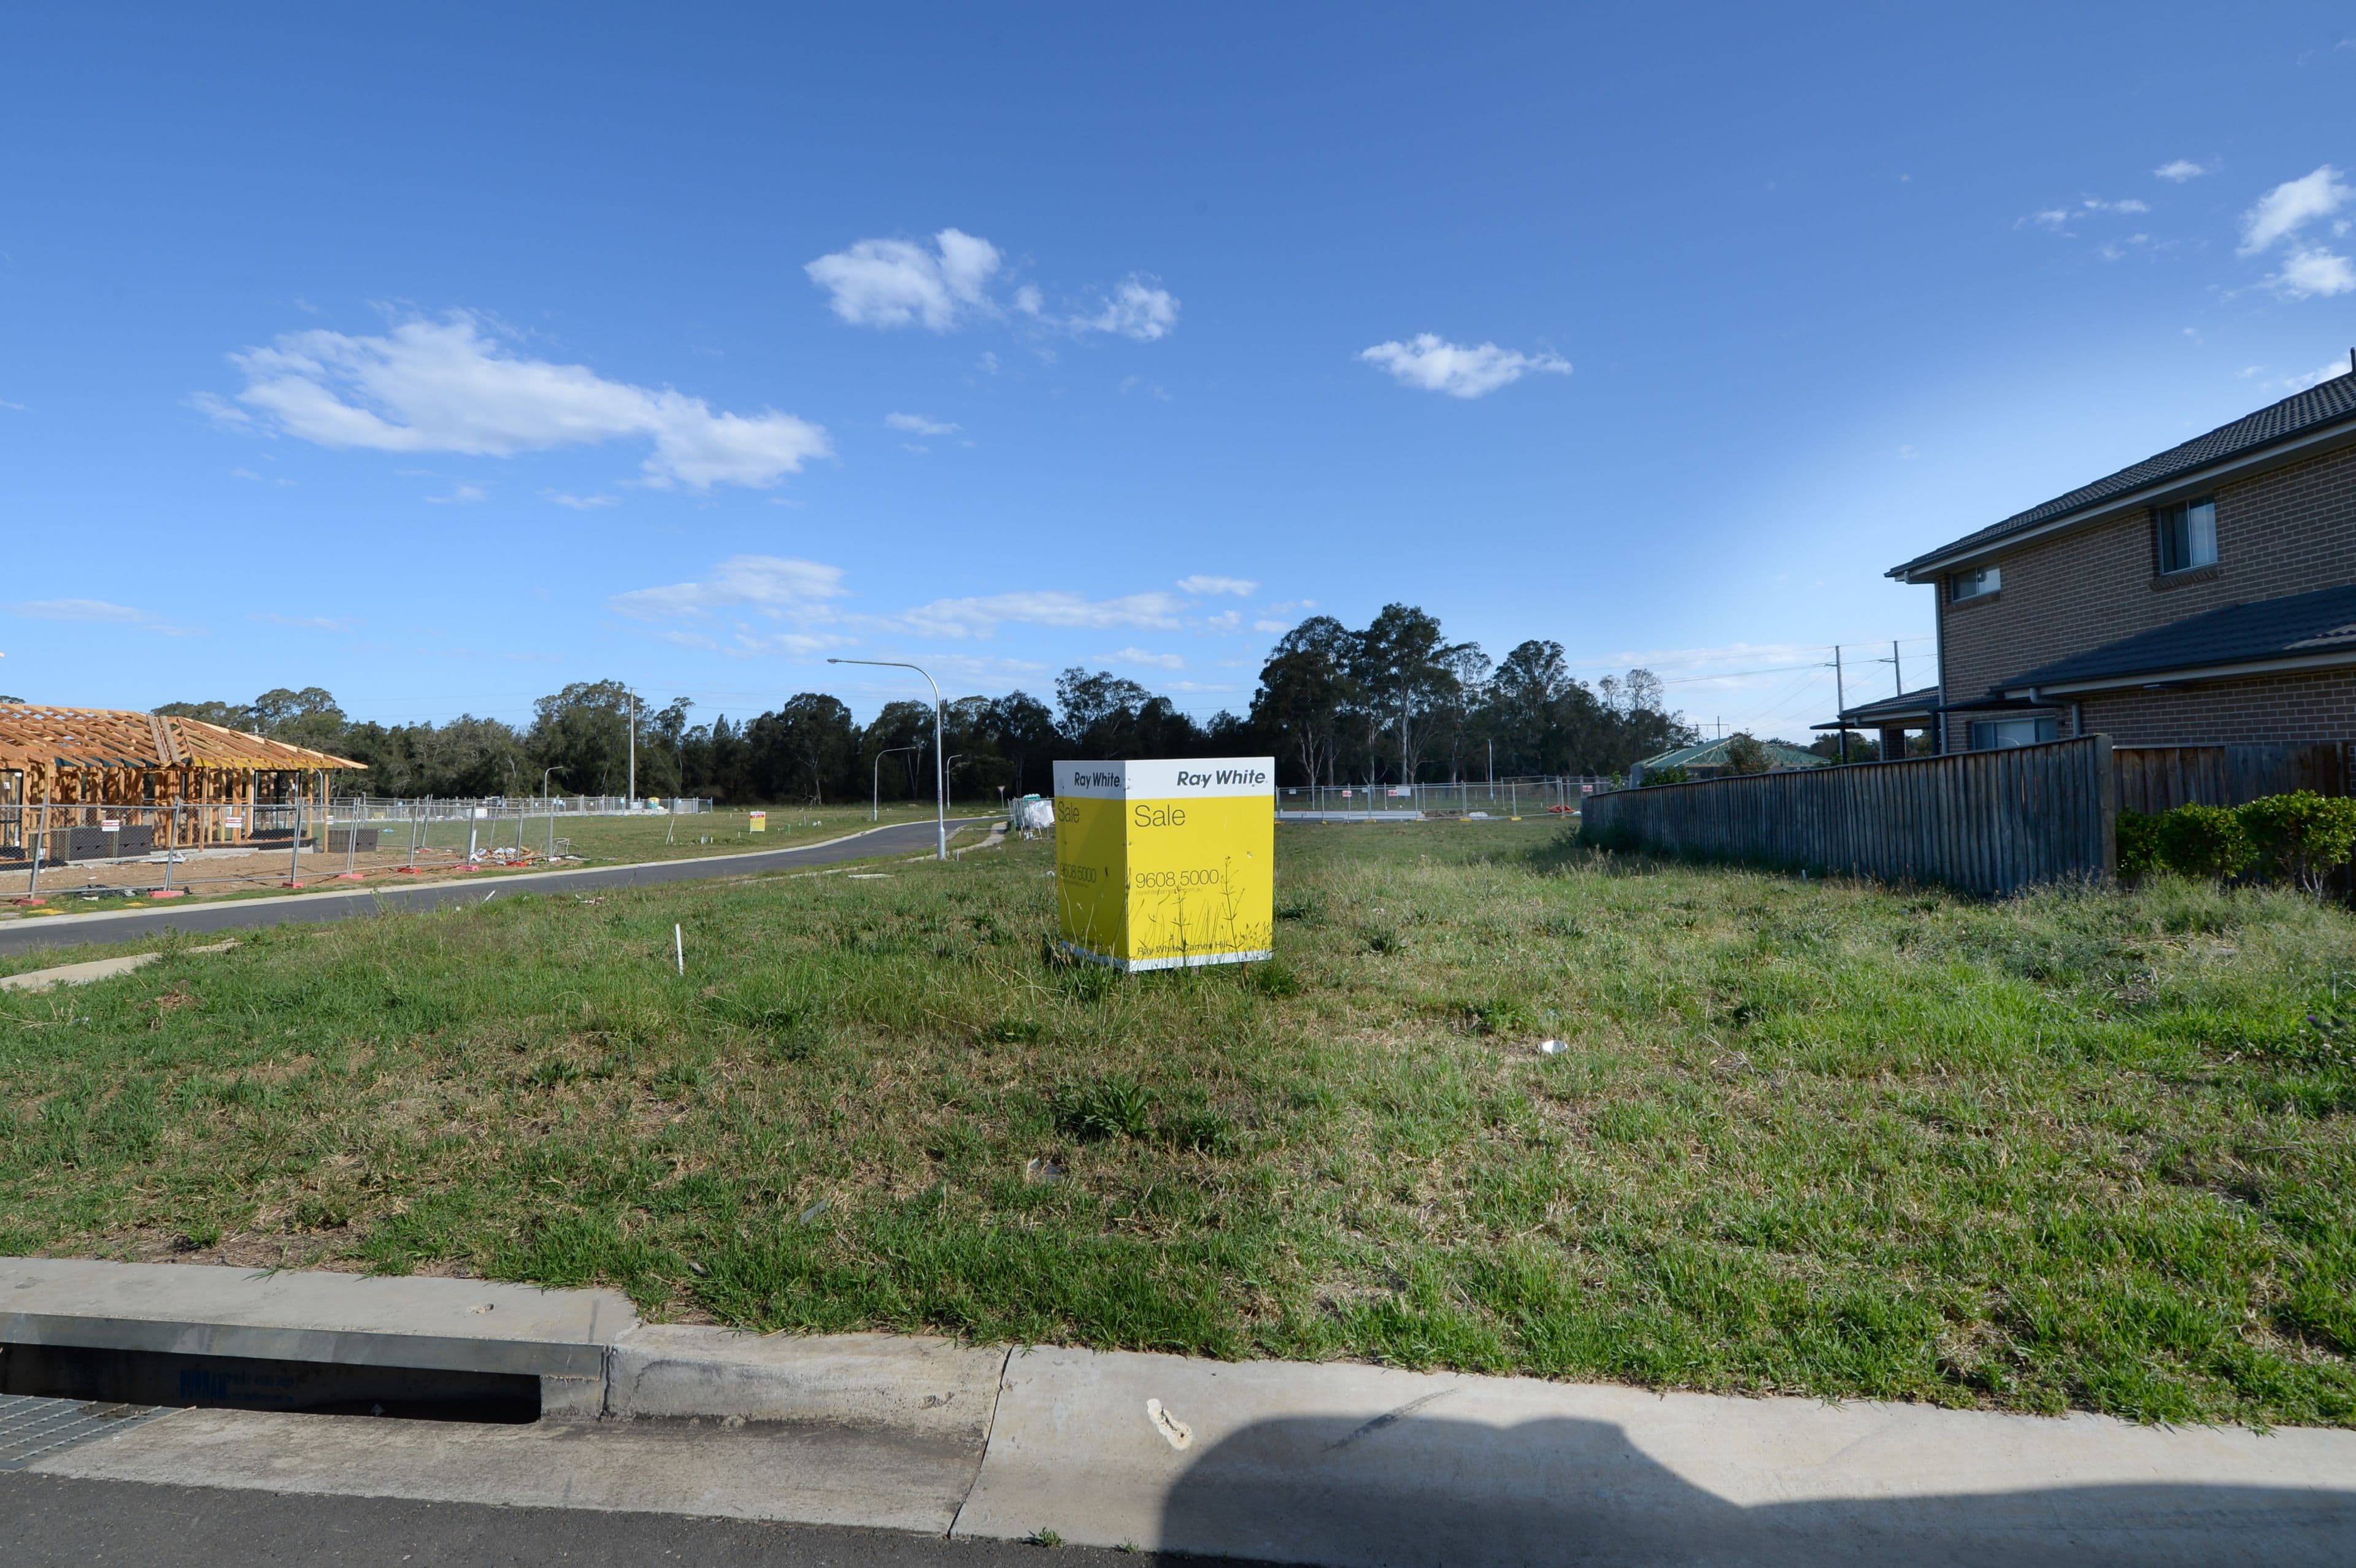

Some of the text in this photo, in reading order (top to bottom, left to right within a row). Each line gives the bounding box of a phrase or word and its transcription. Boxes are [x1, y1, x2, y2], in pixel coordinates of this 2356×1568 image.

[1074, 772, 1120, 790] Ray White
[1177, 769, 1266, 788] Ray White
[1058, 801, 1080, 823] Sale
[1134, 804, 1185, 827] Sale
[1060, 862, 1096, 883] 9608 5000
[1136, 869, 1219, 888] 9608 5000
